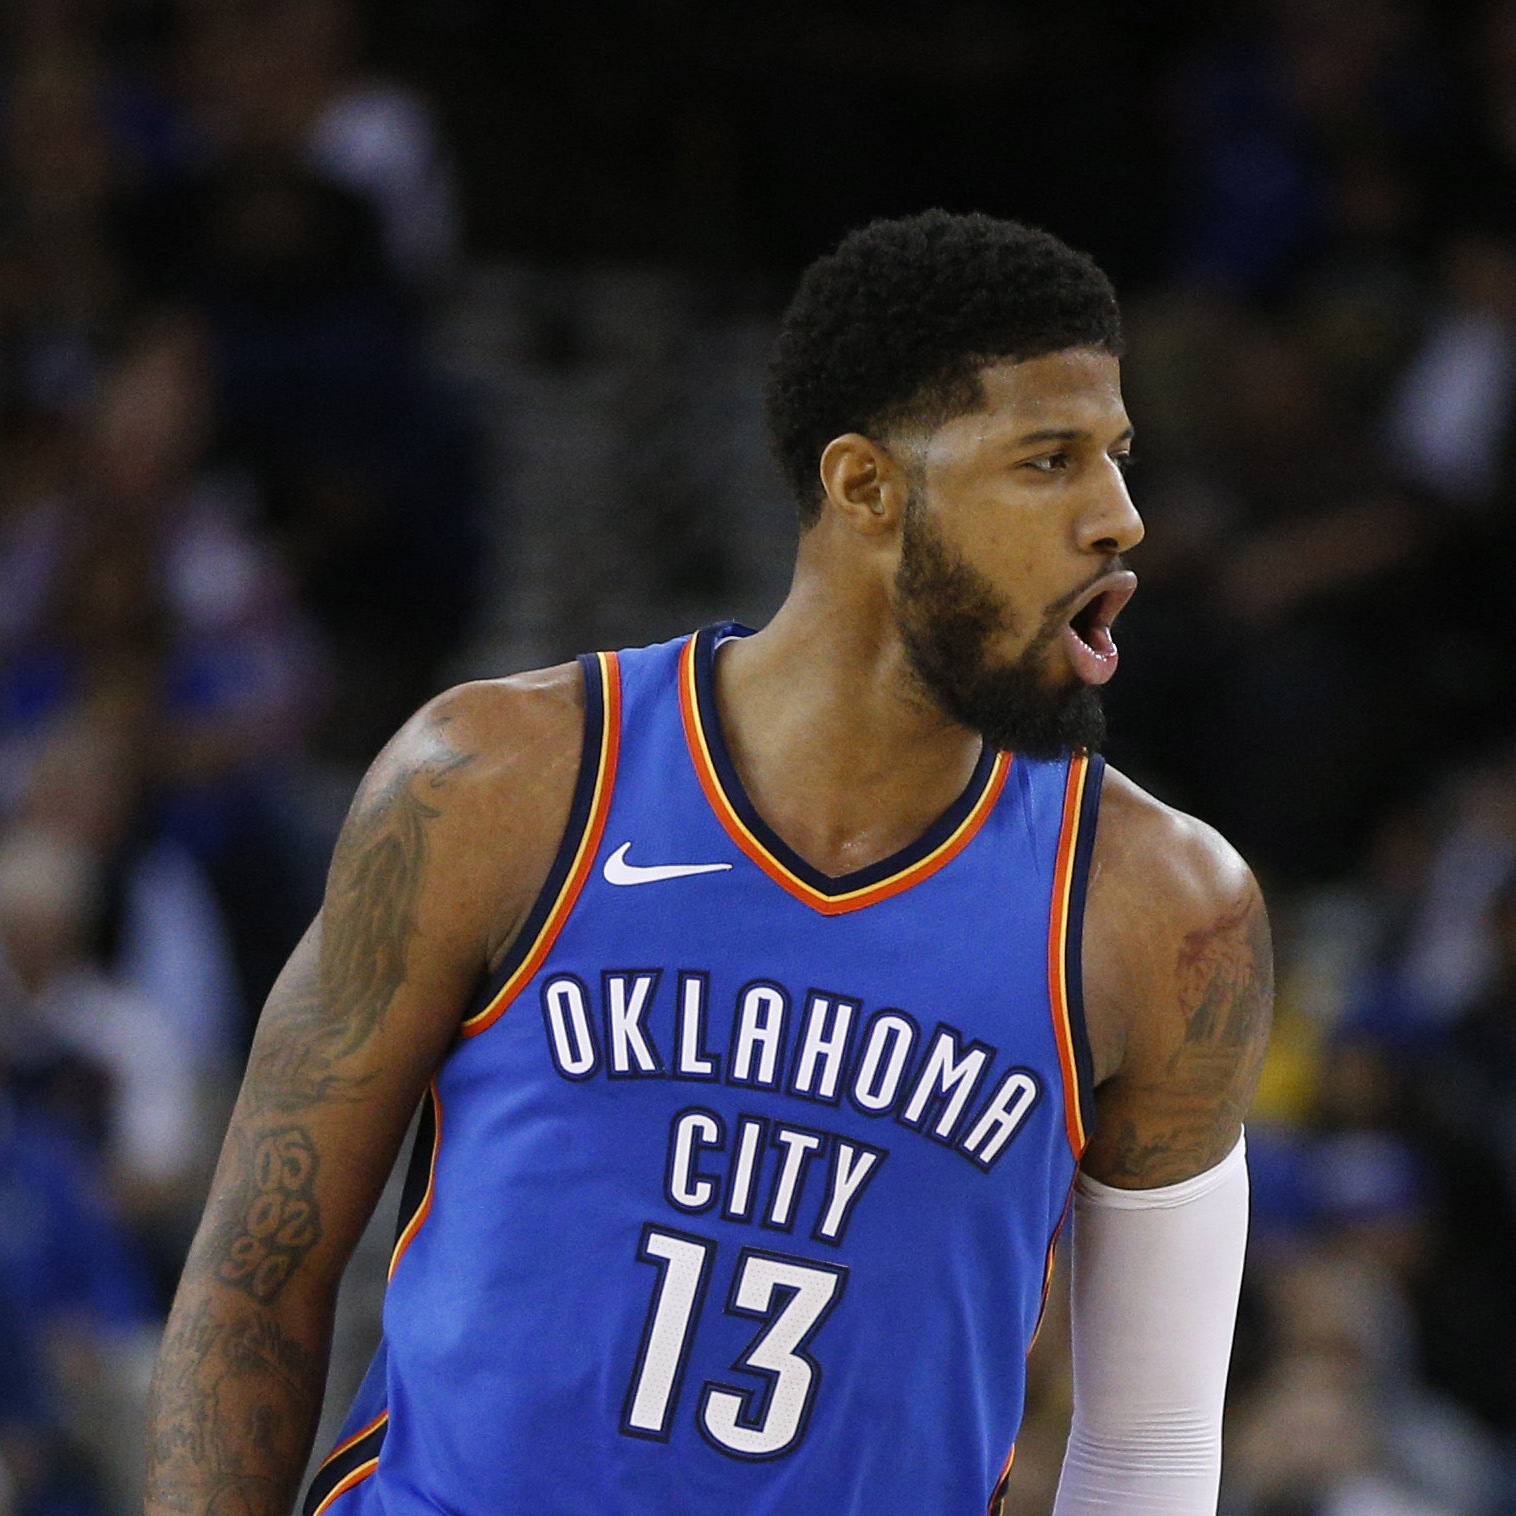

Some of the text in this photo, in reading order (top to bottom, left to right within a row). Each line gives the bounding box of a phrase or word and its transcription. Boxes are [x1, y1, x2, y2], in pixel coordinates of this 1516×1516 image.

[540, 968, 1045, 1174] OKLAHOMA
[663, 1106, 886, 1248] CITY
[618, 1222, 849, 1463] 13
